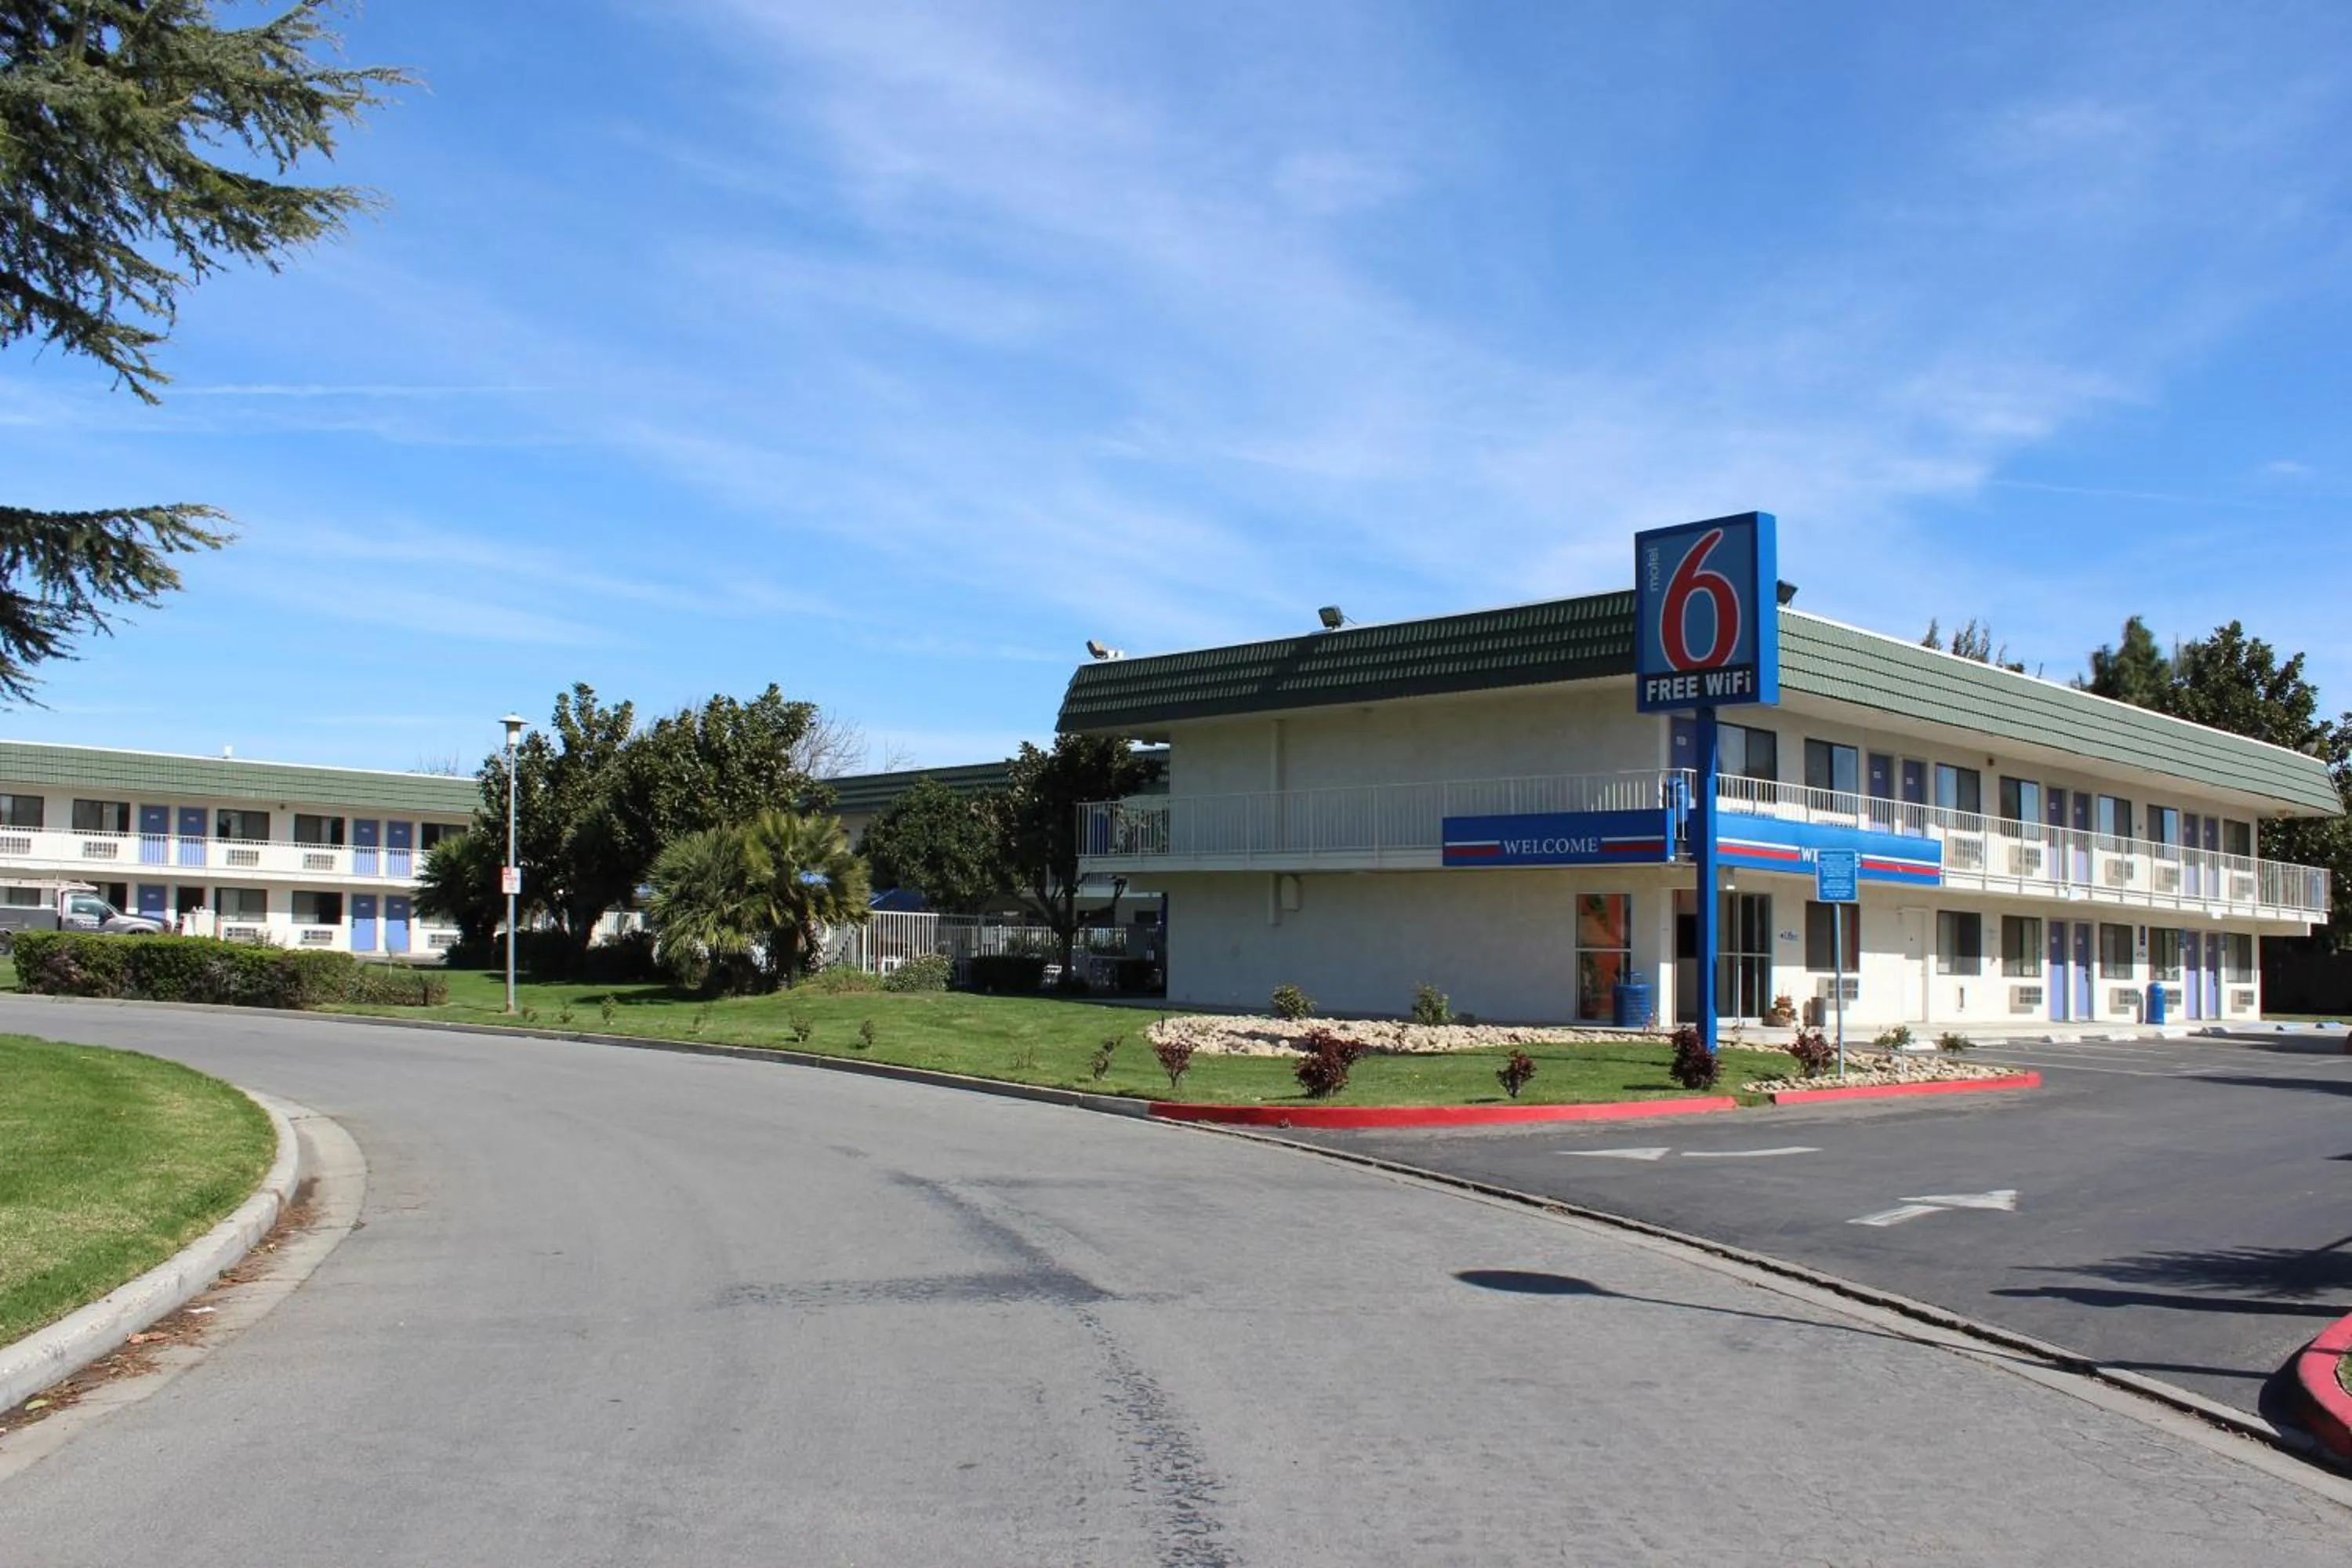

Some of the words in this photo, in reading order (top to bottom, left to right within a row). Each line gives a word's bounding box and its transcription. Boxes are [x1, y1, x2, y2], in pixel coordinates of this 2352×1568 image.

[1648, 548, 1659, 591] motel
[1659, 528, 1740, 672] 6
[1646, 676, 1698, 702] FREE
[1706, 671, 1751, 696] WiFi
[1504, 837, 1599, 855] WELCOME
